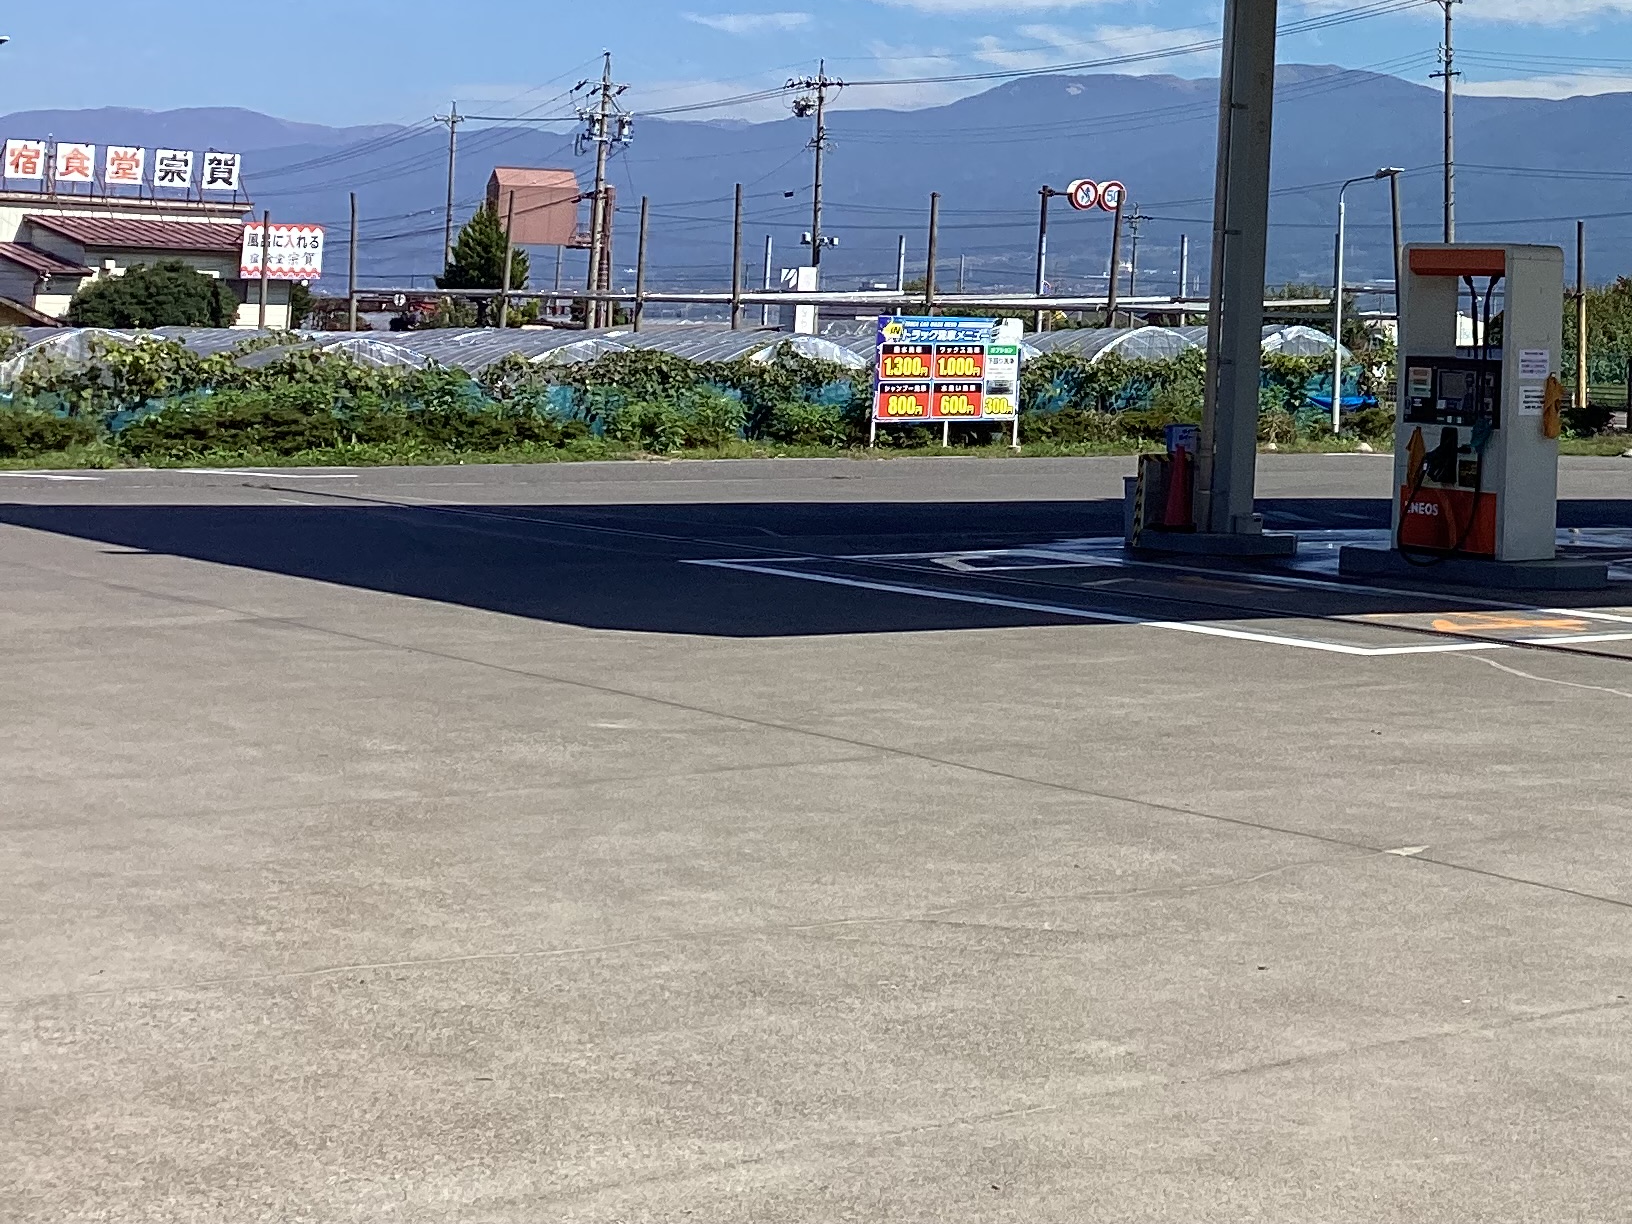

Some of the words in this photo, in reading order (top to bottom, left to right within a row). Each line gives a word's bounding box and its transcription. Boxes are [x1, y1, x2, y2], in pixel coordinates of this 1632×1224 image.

[887, 395, 923, 416] 800円
[940, 395, 975, 416] 600円
[984, 396, 1013, 415] 300円
